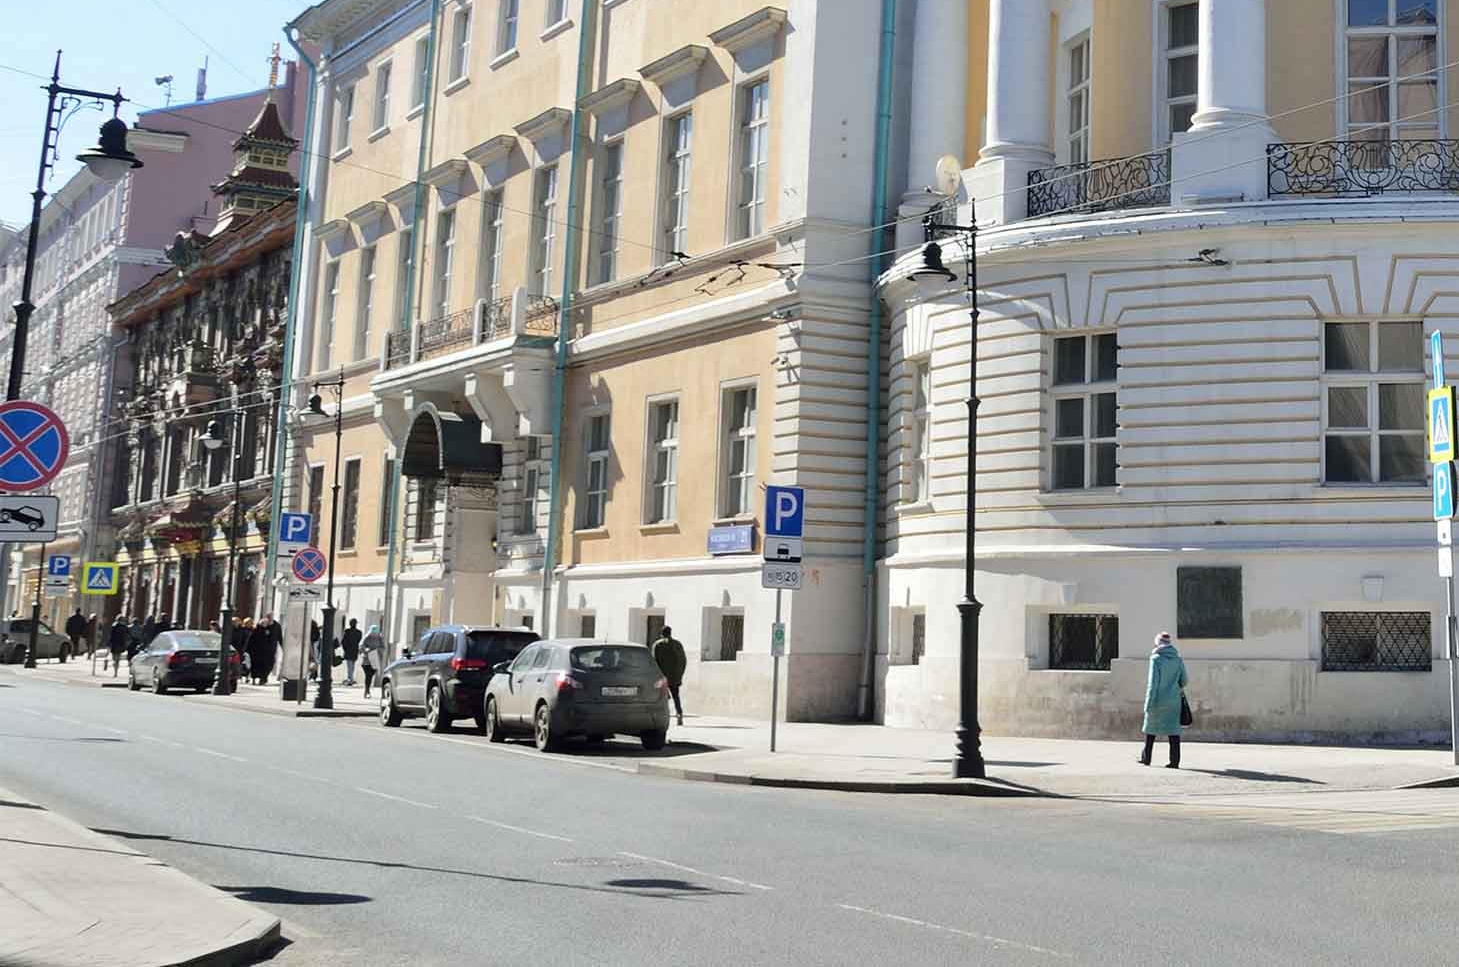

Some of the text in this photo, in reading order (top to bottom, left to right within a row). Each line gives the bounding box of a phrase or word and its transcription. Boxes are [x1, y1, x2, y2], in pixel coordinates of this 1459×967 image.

[1437, 469, 1446, 511] P
[775, 491, 798, 531] P
[287, 516, 306, 538] P
[54, 557, 67, 574] P
